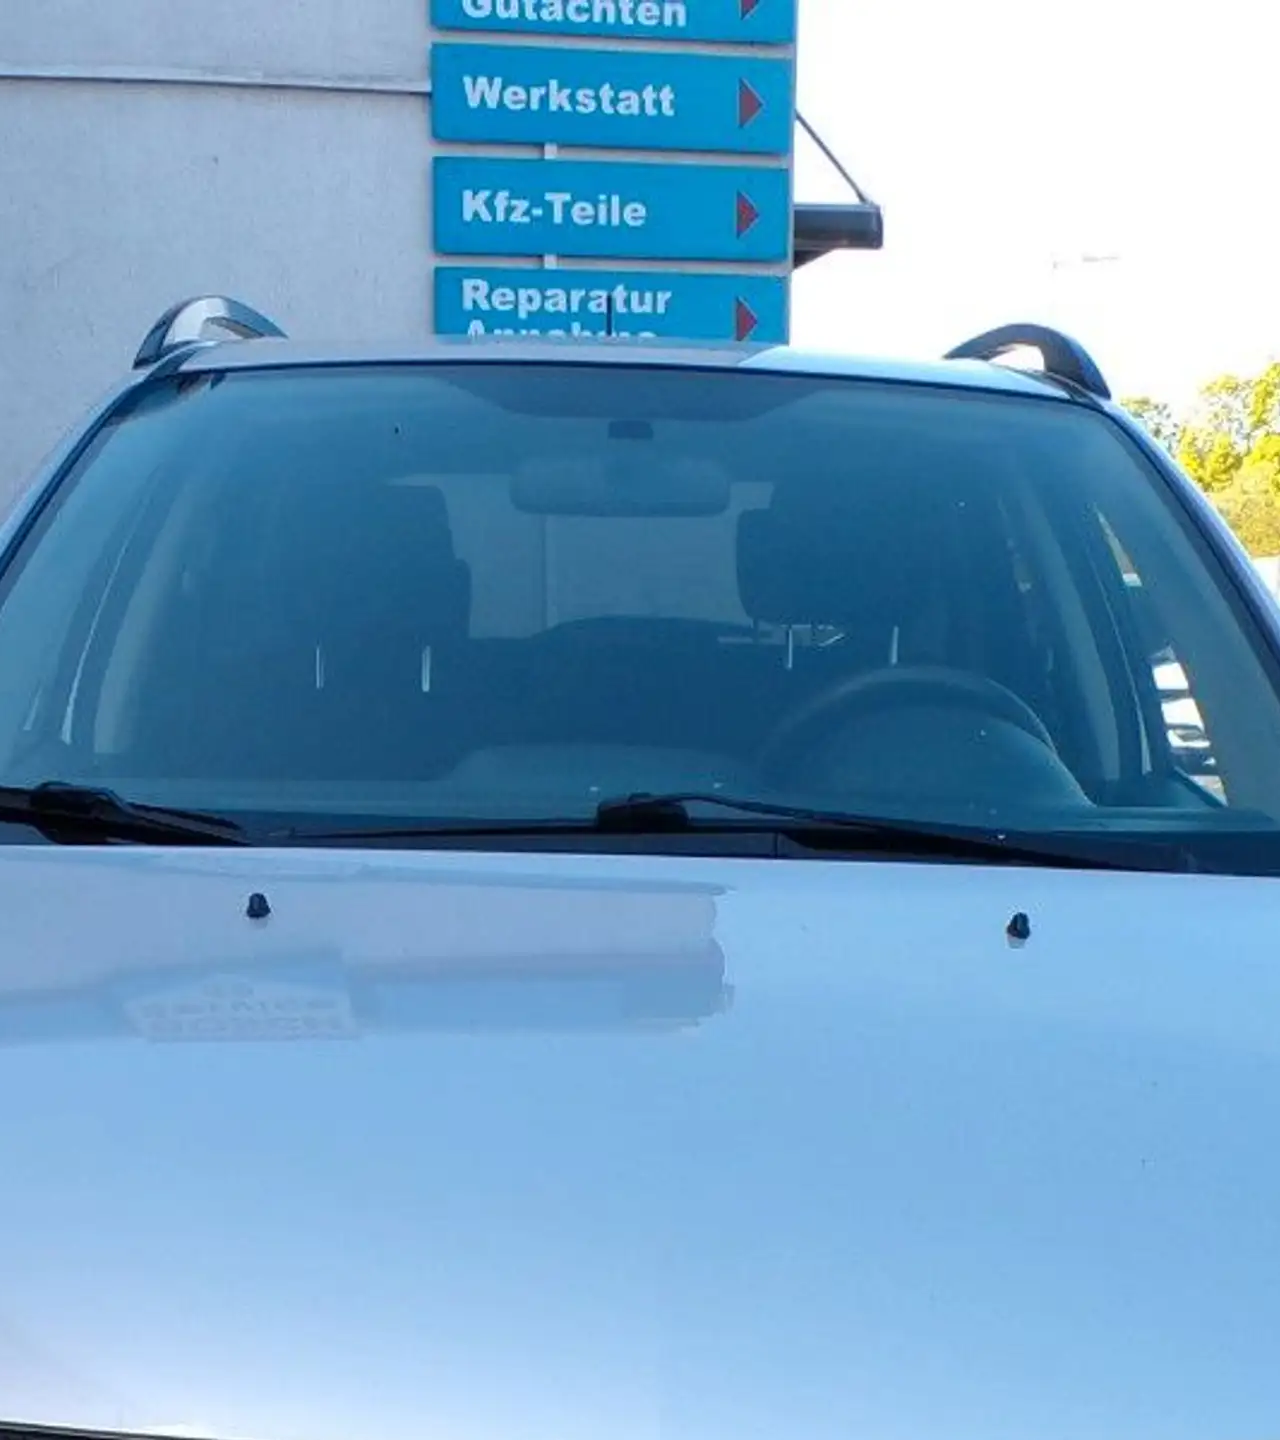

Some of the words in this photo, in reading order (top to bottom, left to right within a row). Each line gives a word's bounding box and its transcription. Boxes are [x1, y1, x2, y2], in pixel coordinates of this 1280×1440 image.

[460, 0, 687, 28] Gutachten
[461, 75, 676, 117] Werkstatt
[461, 189, 648, 228] Kfz-Teile
[461, 278, 672, 318] Reparatur
